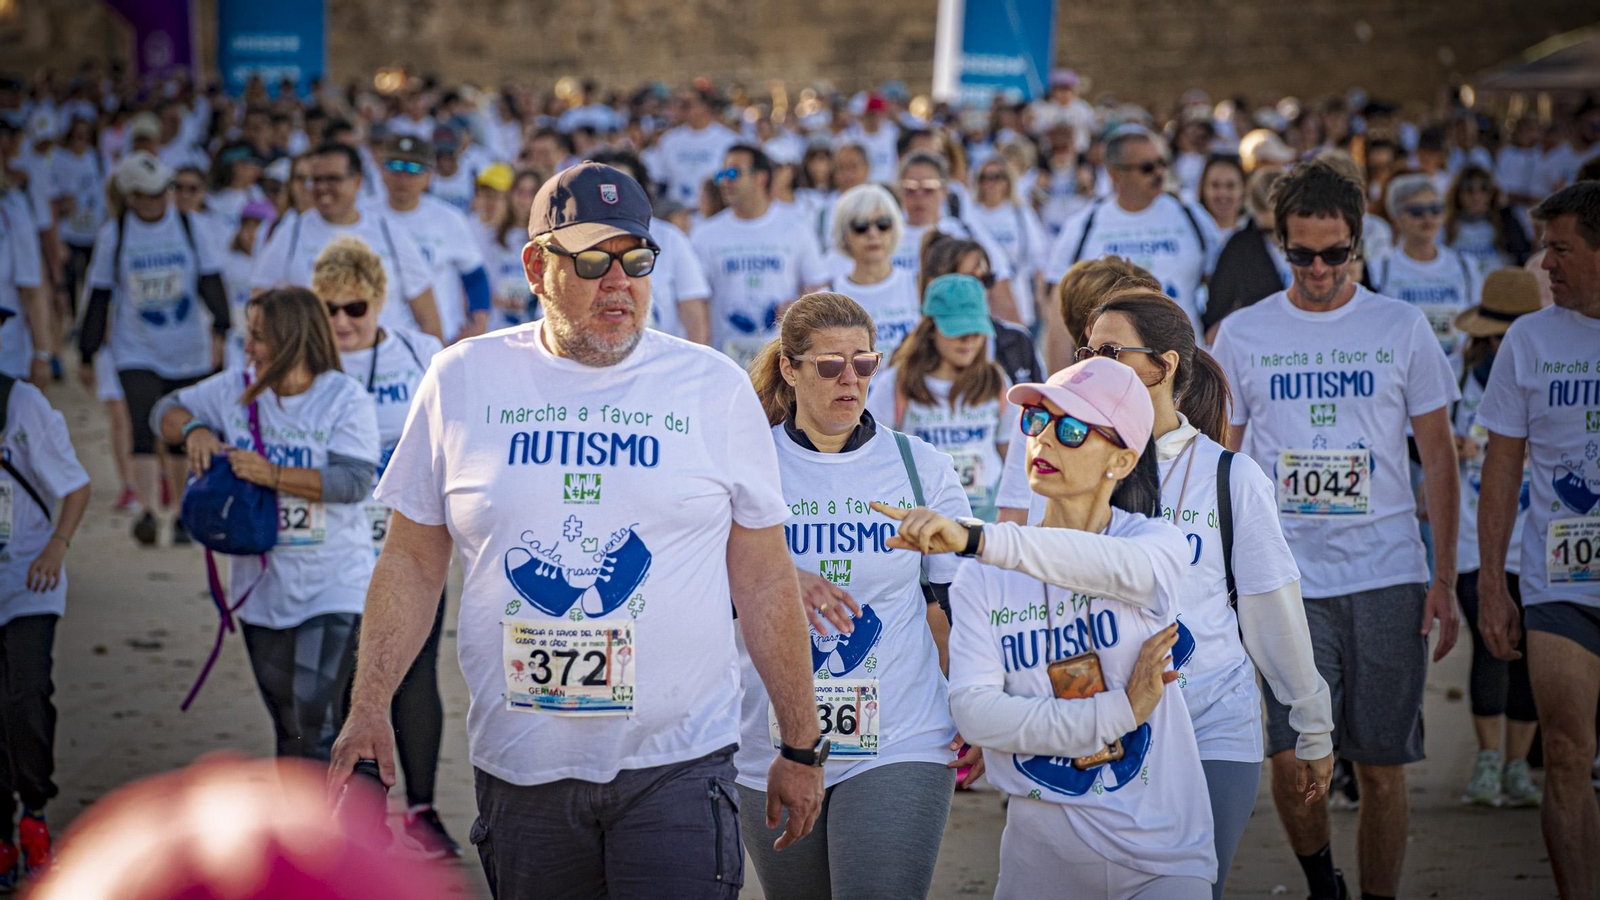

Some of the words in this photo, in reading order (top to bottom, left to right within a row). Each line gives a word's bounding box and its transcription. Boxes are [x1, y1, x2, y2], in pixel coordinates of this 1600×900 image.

[1261, 351, 1309, 367] marcha
[1316, 352, 1323, 365] a
[1331, 348, 1368, 364] favor
[1376, 347, 1395, 364] del
[1543, 359, 1589, 374] marcha
[1270, 370, 1375, 400] AUTISMO
[500, 403, 567, 424] marcha
[578, 406, 589, 421] a
[600, 405, 653, 426] favor
[664, 411, 690, 435] del
[508, 430, 660, 467] AUTISMO
[1288, 469, 1361, 497] 1042
[279, 507, 309, 531] 32
[828, 500, 836, 515] a
[520, 530, 566, 568] Cada
[566, 566, 601, 586] paso
[592, 523, 639, 563] cuenta
[1055, 601, 1065, 617] a
[520, 627, 546, 637] MARCHA
[556, 629, 578, 638] FAVOR
[580, 629, 593, 637] DEL
[529, 649, 607, 687] 372
[528, 686, 566, 698] GERMÁN
[817, 703, 857, 735] 36
